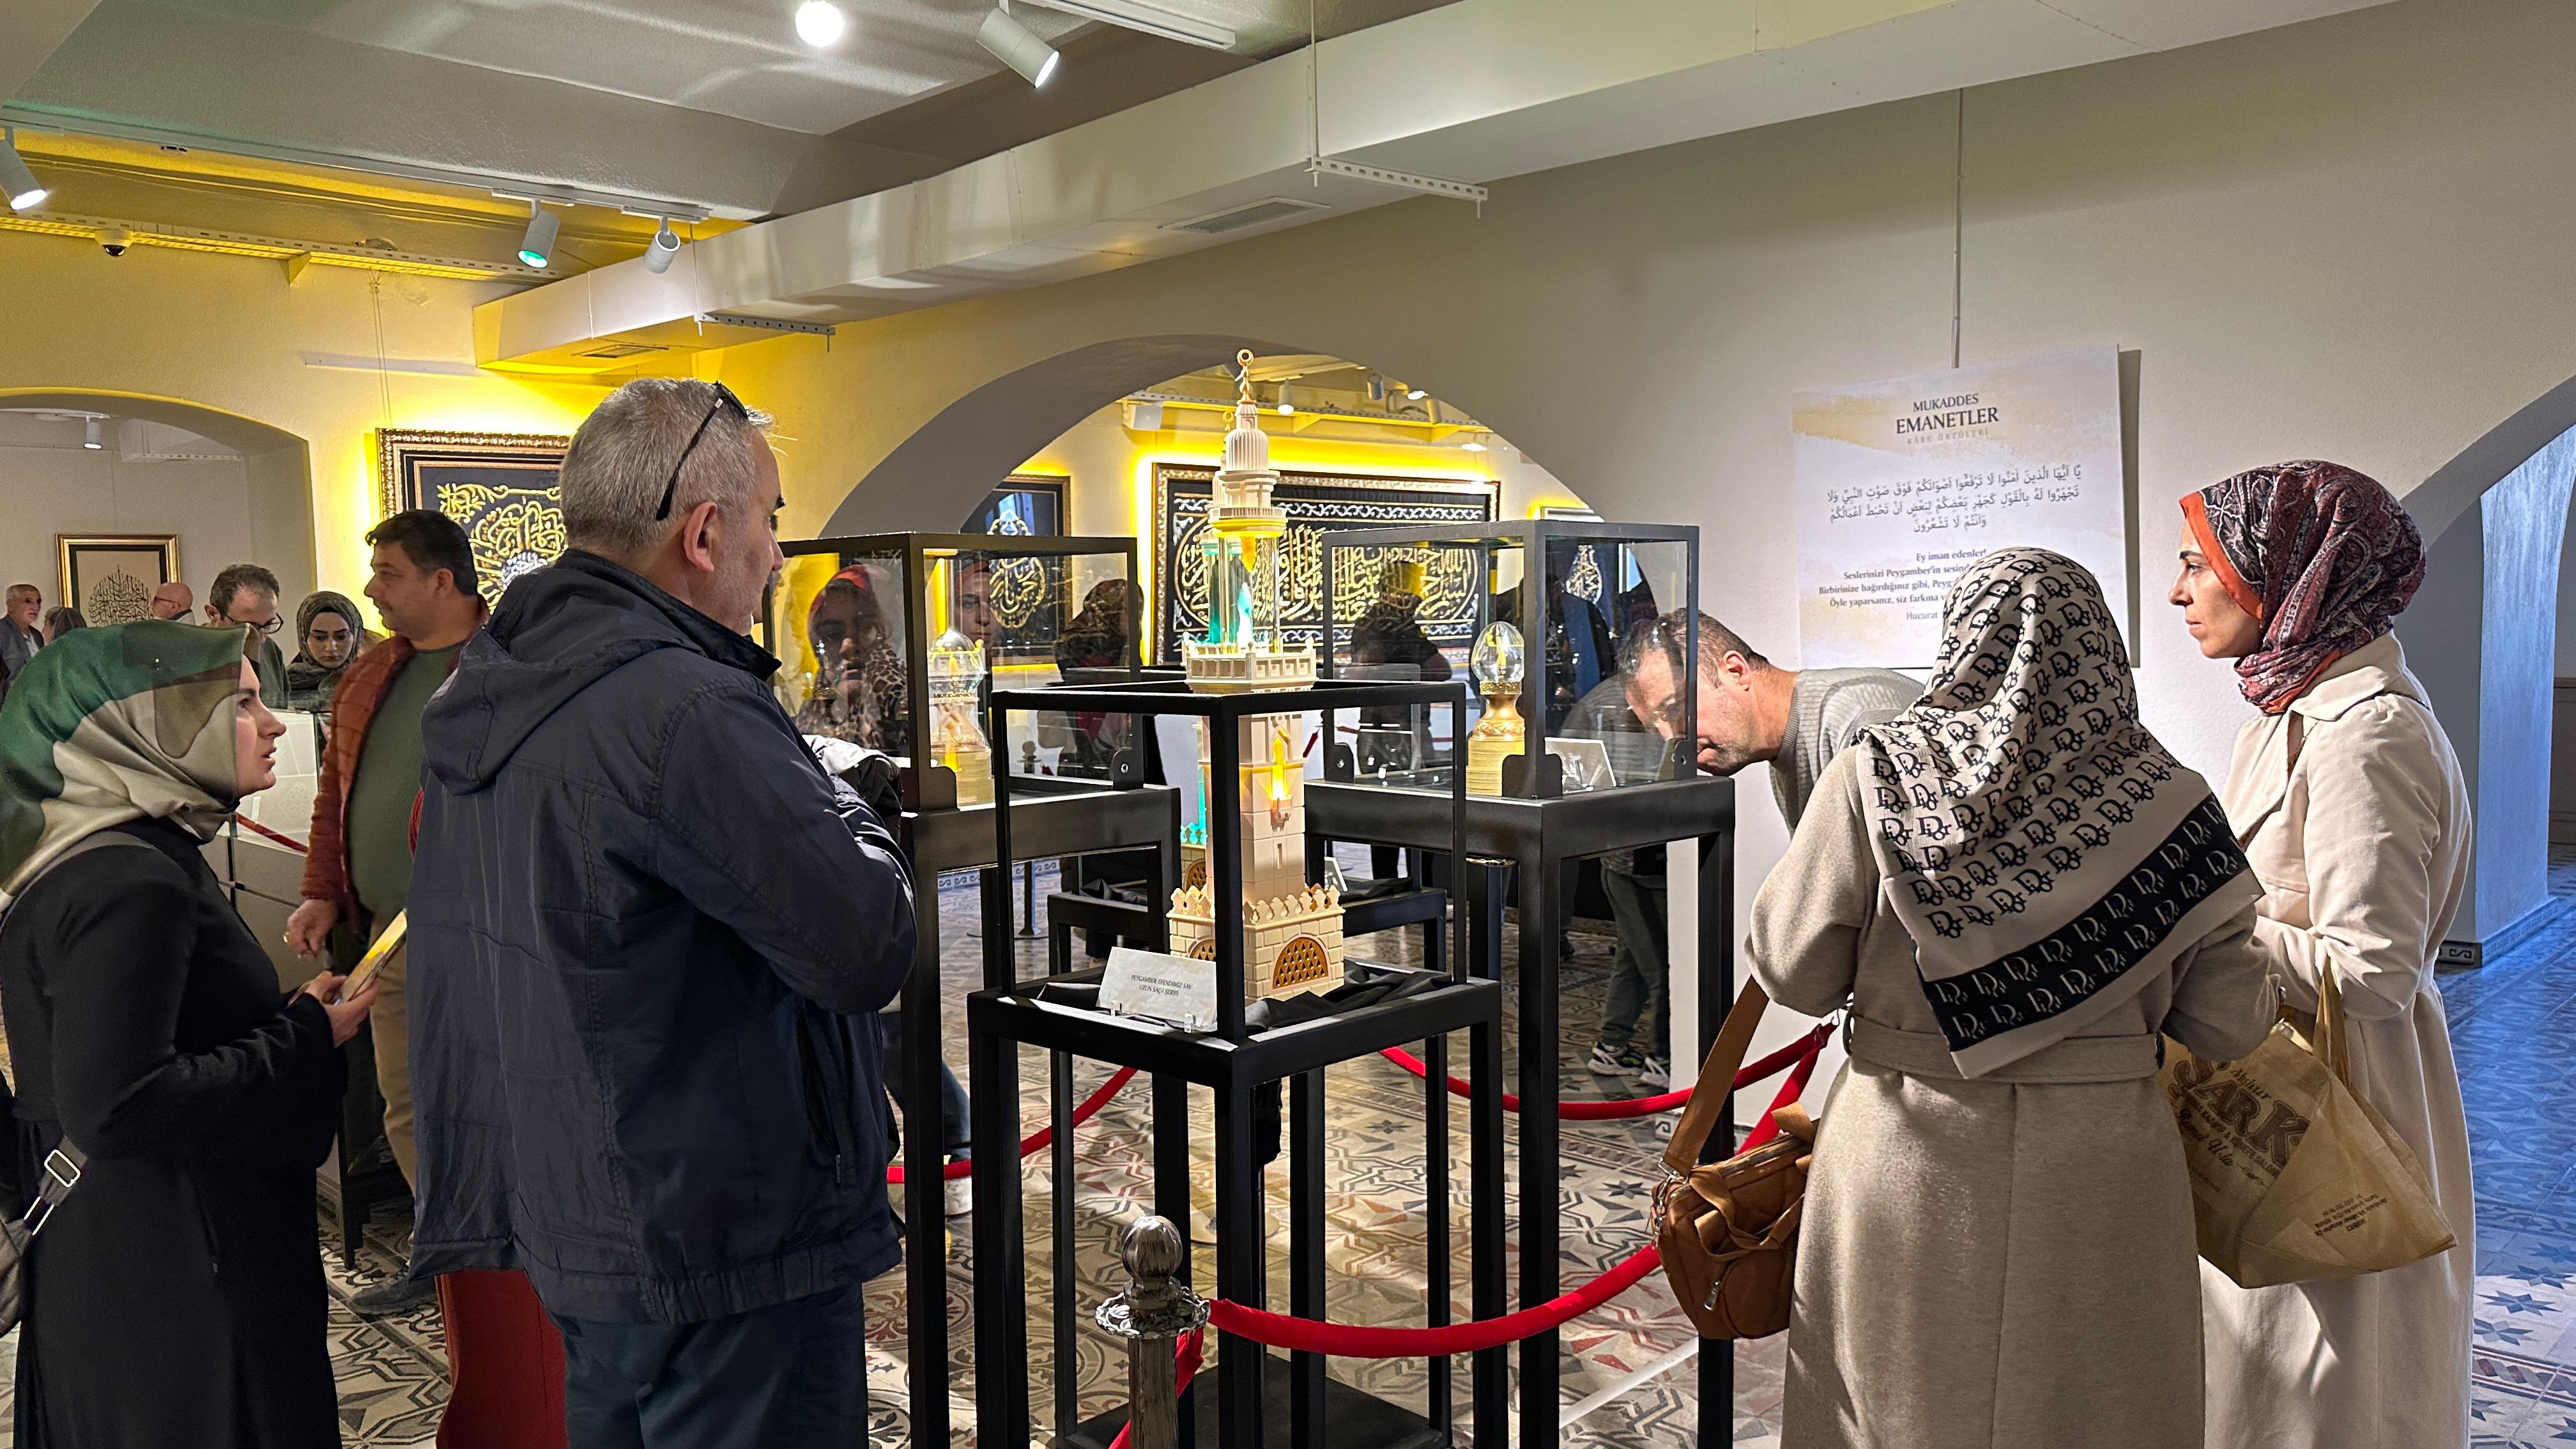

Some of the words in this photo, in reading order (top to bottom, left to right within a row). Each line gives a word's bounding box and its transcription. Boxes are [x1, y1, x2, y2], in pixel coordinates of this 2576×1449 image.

[1913, 394, 1979, 412] MUKADDES
[1896, 407, 1998, 434] EMANETLER
[1917, 553, 1926, 563] Ey
[1928, 552, 1949, 560] iman
[1843, 569, 1883, 579] Seslerinizi
[1887, 565, 1940, 578] Peygamber'in
[1943, 564, 1970, 573] sesind
[1819, 586, 1859, 594] Birbirinize
[1861, 583, 1909, 593] bağırdığınız
[1912, 580, 1930, 590] gibi,
[1830, 597, 1847, 608] Öyle
[1910, 594, 1938, 602] farkına
[1906, 611, 1938, 620] Hucurat
